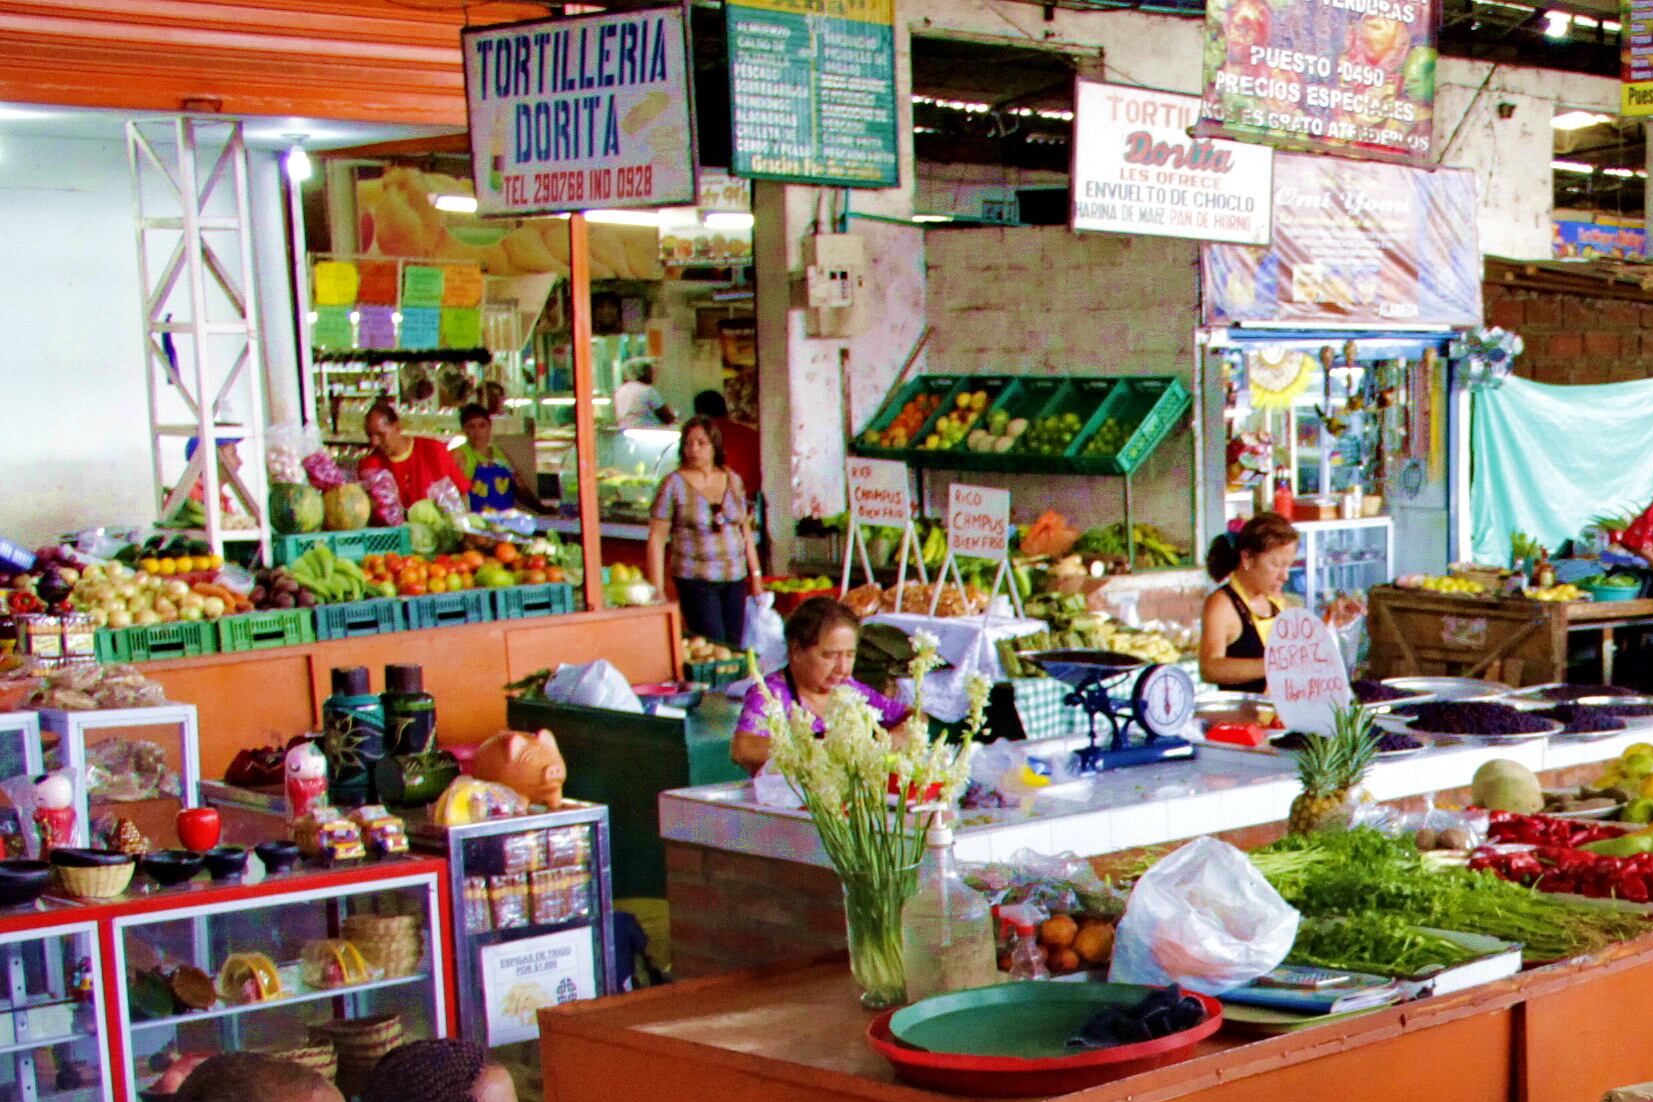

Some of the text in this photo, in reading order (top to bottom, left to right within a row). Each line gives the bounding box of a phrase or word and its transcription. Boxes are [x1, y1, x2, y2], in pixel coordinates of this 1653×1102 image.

[477, 18, 667, 100] TORTILLERIA
[1251, 46, 1331, 77] PUESTO
[1215, 71, 1416, 122] PRECIOS ESPECIALES
[515, 94, 620, 163] DORITA
[1242, 107, 1264, 126] ES
[1268, 112, 1323, 136] GRATO
[1123, 131, 1236, 175] Dorita
[504, 174, 528, 205] TEL
[534, 170, 584, 203] 290768
[617, 164, 653, 198] 0928
[1120, 167, 1222, 190] LES OFRECE
[1086, 181, 1166, 205] ENVUELTO
[1170, 189, 1189, 207] DE
[1193, 191, 1254, 213] CHOCLO
[1076, 201, 1117, 220] HARINA
[1121, 205, 1134, 222] DE
[1170, 209, 1194, 226] PAN
[1196, 211, 1209, 227] DE
[1214, 214, 1250, 231] HORNO
[954, 488, 982, 507] RICO
[953, 535, 981, 550] BIEN
[1276, 612, 1314, 640] OJO
[500, 946, 572, 969] ESPIGAS DE TRIGO
